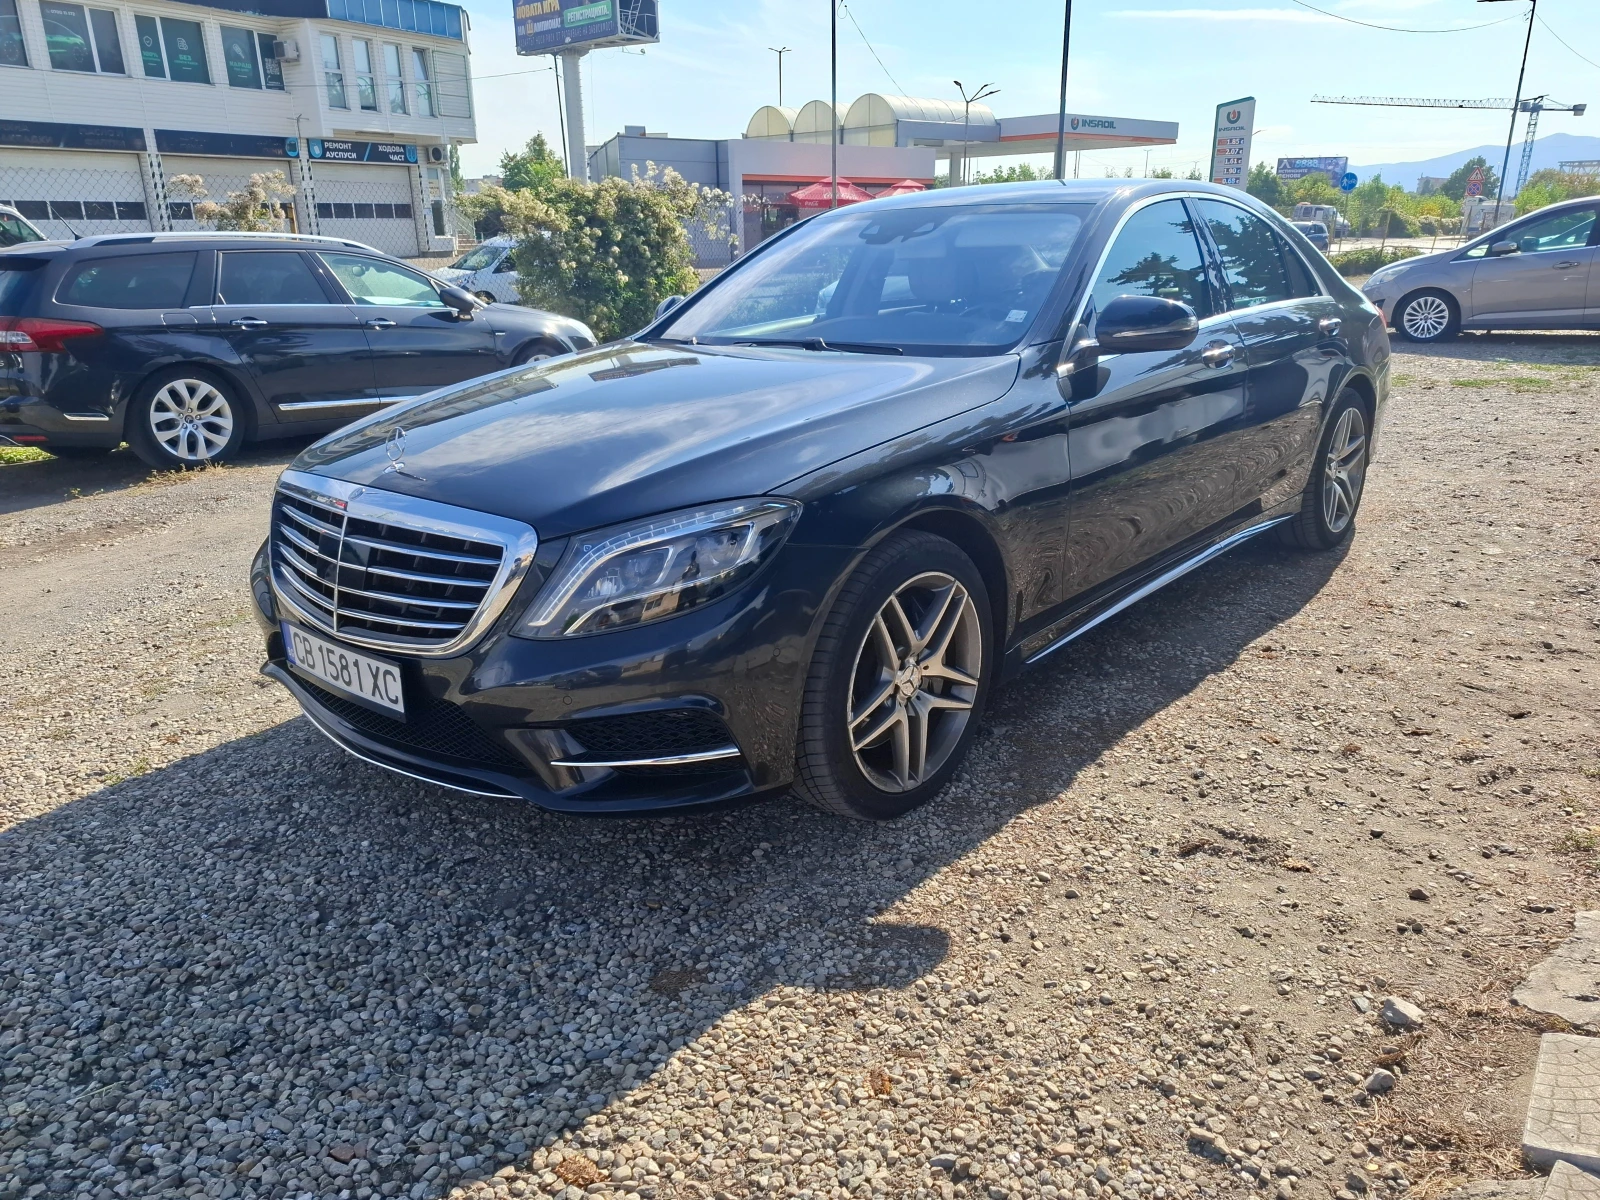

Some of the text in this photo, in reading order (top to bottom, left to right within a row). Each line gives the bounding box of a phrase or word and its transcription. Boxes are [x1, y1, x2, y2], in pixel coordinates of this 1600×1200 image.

[516, 0, 560, 19] НОВАТА ИГРА
[1081, 119, 1116, 129] INSAOIL
[324, 141, 352, 150] РЕМОНТ
[377, 144, 405, 153] ХОДОВА
[325, 151, 357, 159] АУСПУСИ
[293, 632, 399, 705] CB 1581 XC
